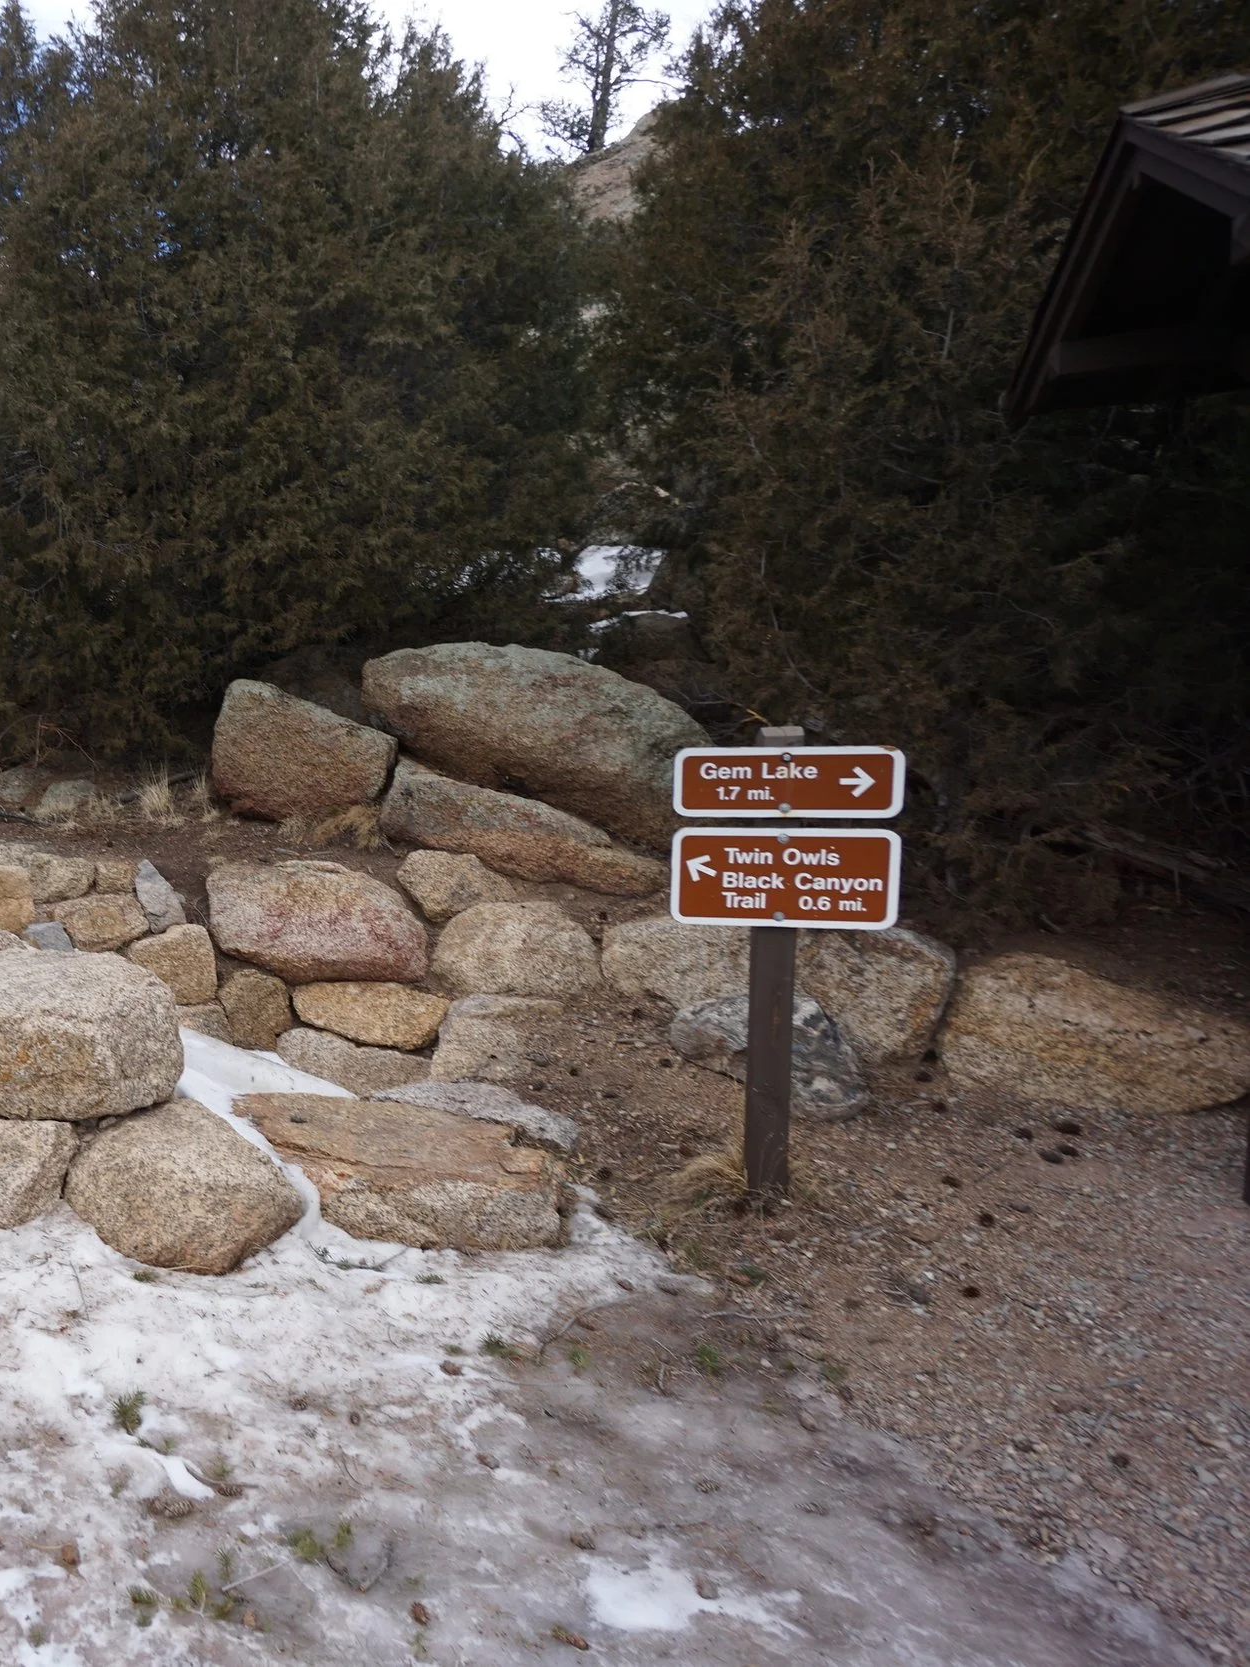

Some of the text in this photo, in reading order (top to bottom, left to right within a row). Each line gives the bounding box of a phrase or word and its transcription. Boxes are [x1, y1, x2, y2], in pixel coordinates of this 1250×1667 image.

[700, 762, 819, 780] Gem Lake
[716, 786, 775, 801] 1.7 mi.
[724, 847, 841, 866] Twin Owls
[722, 872, 883, 895] Black Canyon
[722, 892, 867, 912] Trail 0.6 mi.
